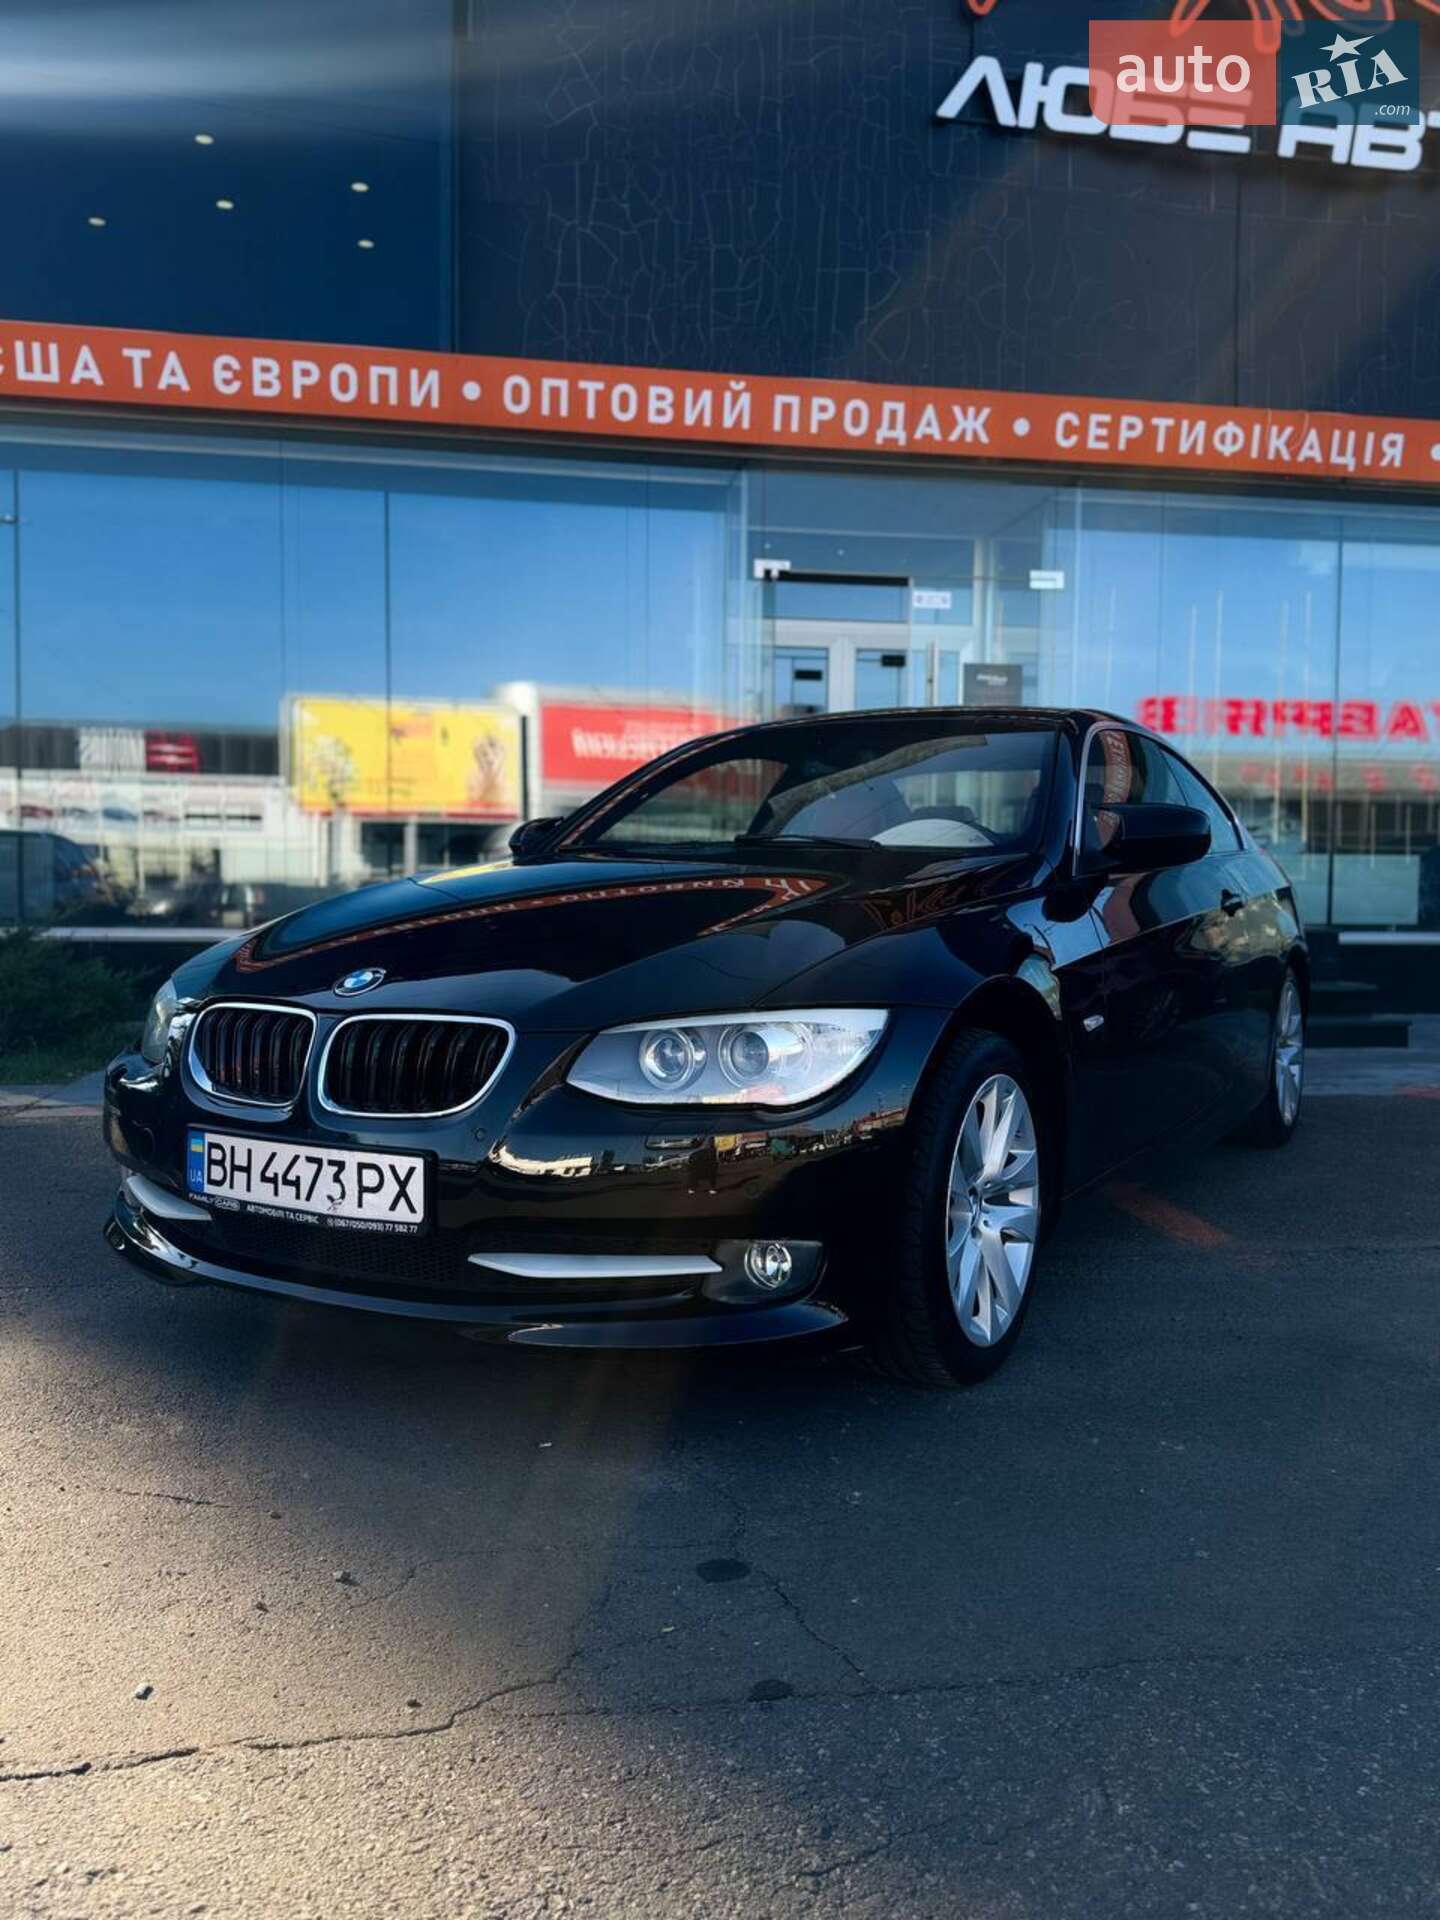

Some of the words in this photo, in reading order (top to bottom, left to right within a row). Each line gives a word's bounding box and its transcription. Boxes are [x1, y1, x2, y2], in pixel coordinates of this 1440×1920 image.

[0, 340, 104, 386] ША
[121, 346, 191, 392] ТА
[212, 354, 440, 409] ЄВРОПИ
[503, 374, 752, 430] ОПТОВИЙ
[772, 394, 991, 446] ПРОДАЖ
[1055, 411, 1405, 472] СЕРТИФІКАЦІЯ
